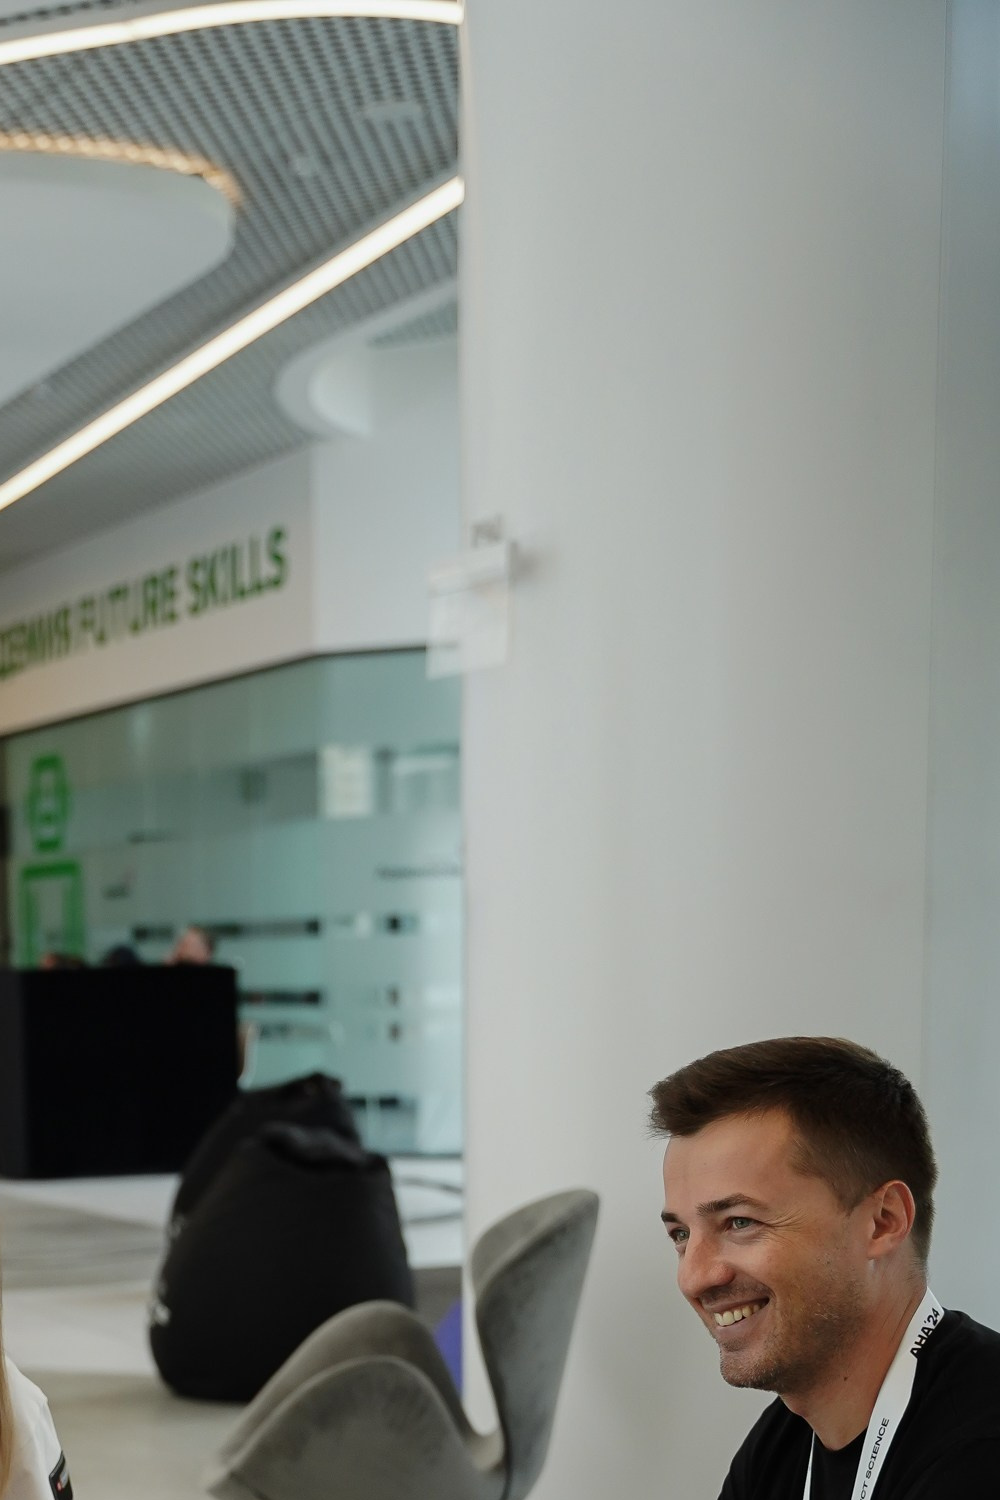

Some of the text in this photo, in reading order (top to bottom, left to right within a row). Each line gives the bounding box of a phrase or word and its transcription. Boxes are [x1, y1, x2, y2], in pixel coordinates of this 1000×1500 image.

[79, 565, 178, 647] FUTURE
[187, 526, 288, 617] SKILLS
[865, 1417, 890, 1480] SCIENCE
